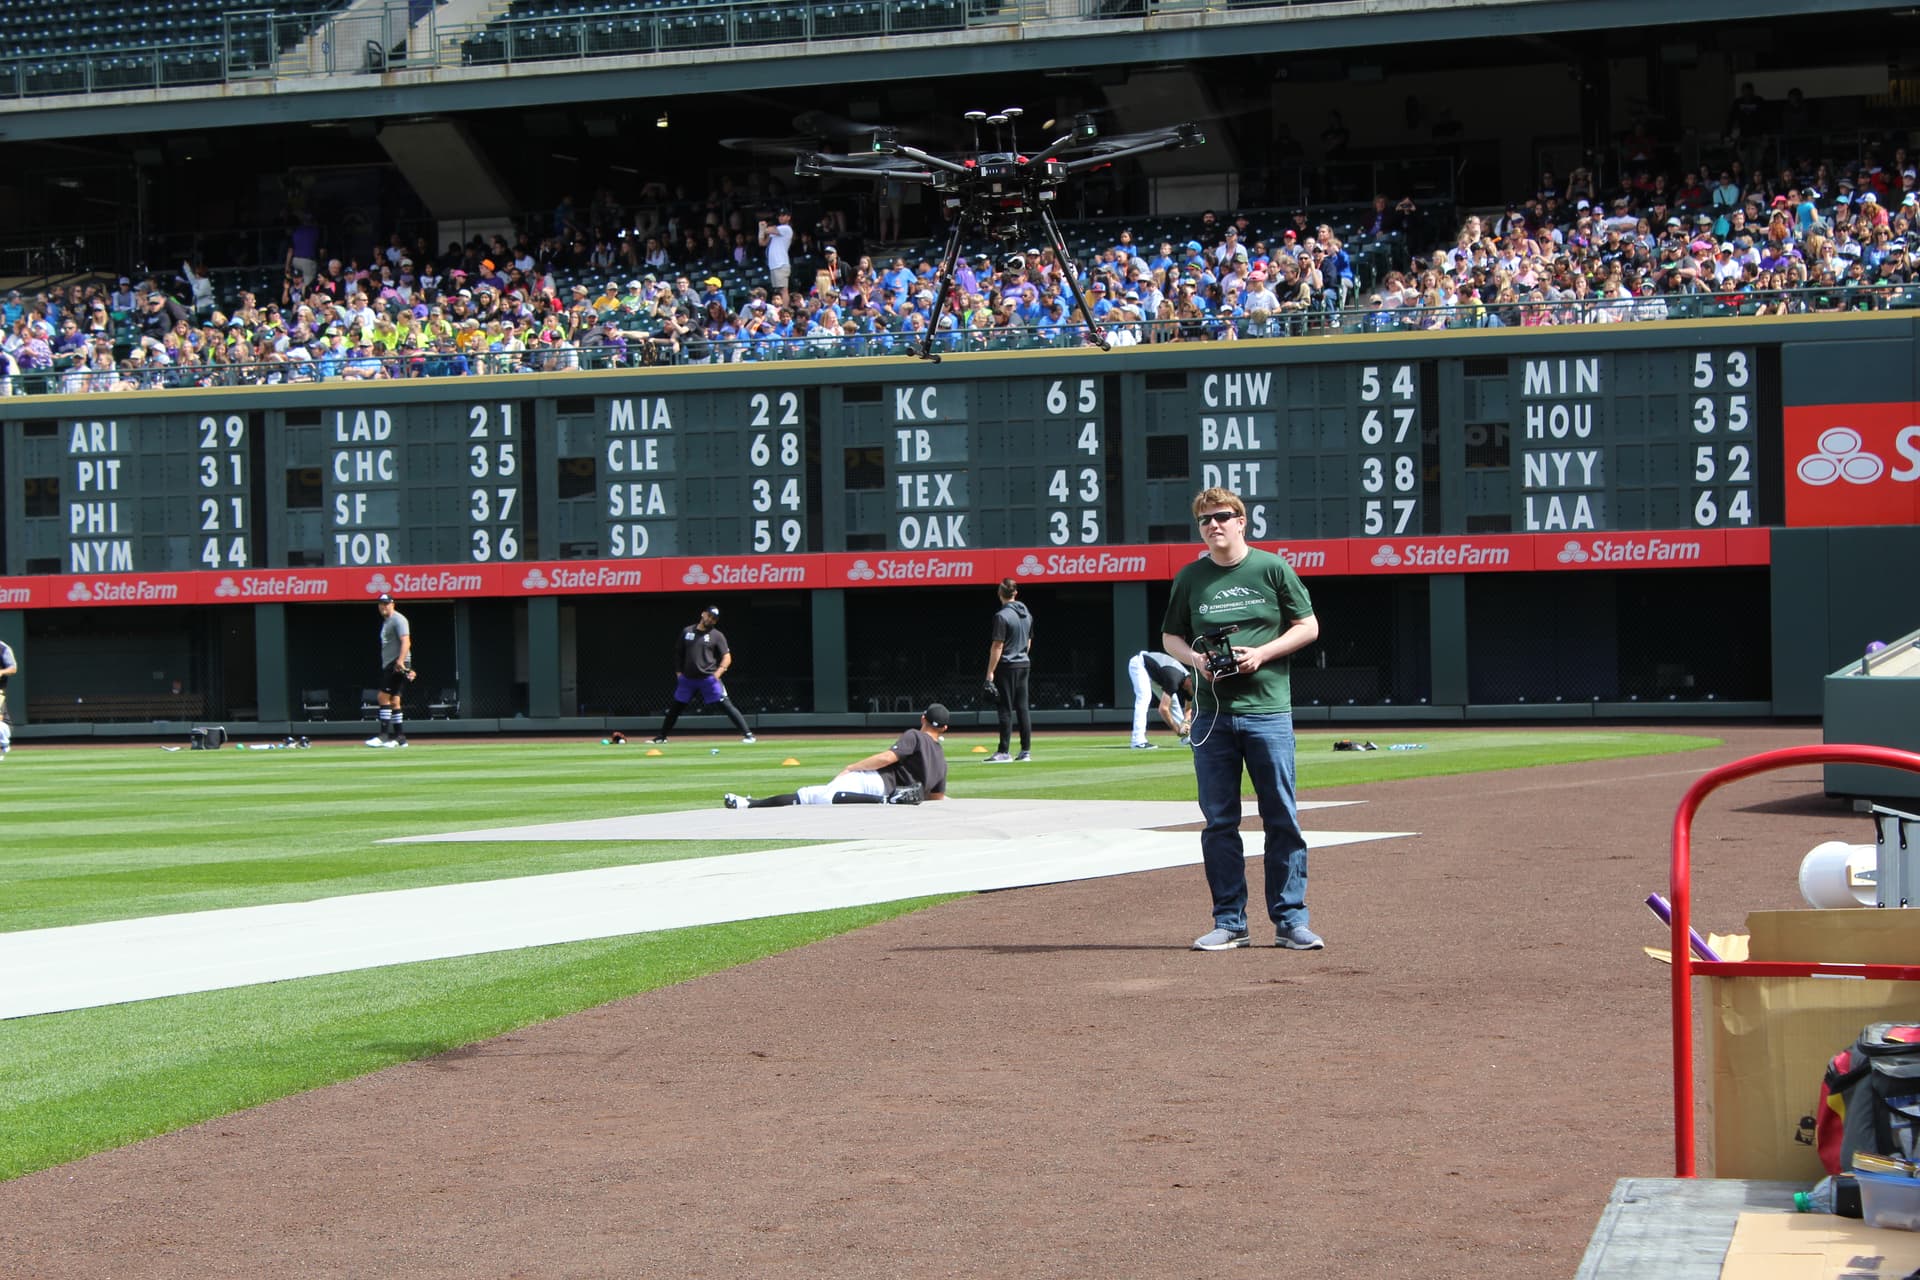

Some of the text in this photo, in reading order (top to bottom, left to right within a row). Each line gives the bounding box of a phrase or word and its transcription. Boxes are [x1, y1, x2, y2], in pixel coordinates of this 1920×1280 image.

[1204, 373, 1271, 406] CHW
[1524, 359, 1597, 394] MIN
[611, 399, 671, 430] MIA
[897, 387, 936, 420] KC
[71, 422, 116, 452] ARI
[338, 411, 391, 441] LAD
[1203, 417, 1260, 450] BAL
[1527, 405, 1591, 438] HOU
[608, 439, 657, 471] CLE
[898, 423, 1098, 461] TB 4
[79, 460, 120, 490] PIT
[335, 450, 392, 482] CHC
[1203, 463, 1260, 496] DET
[1525, 451, 1597, 487] NYY
[610, 484, 665, 516] SEA
[899, 474, 954, 507] TEX
[72, 503, 117, 533] PHI
[336, 494, 366, 524] SF
[1527, 496, 1594, 530] LAA
[611, 525, 648, 556] SD
[900, 516, 966, 548] OAK
[72, 541, 132, 572] NYM
[336, 534, 391, 564] TOR
